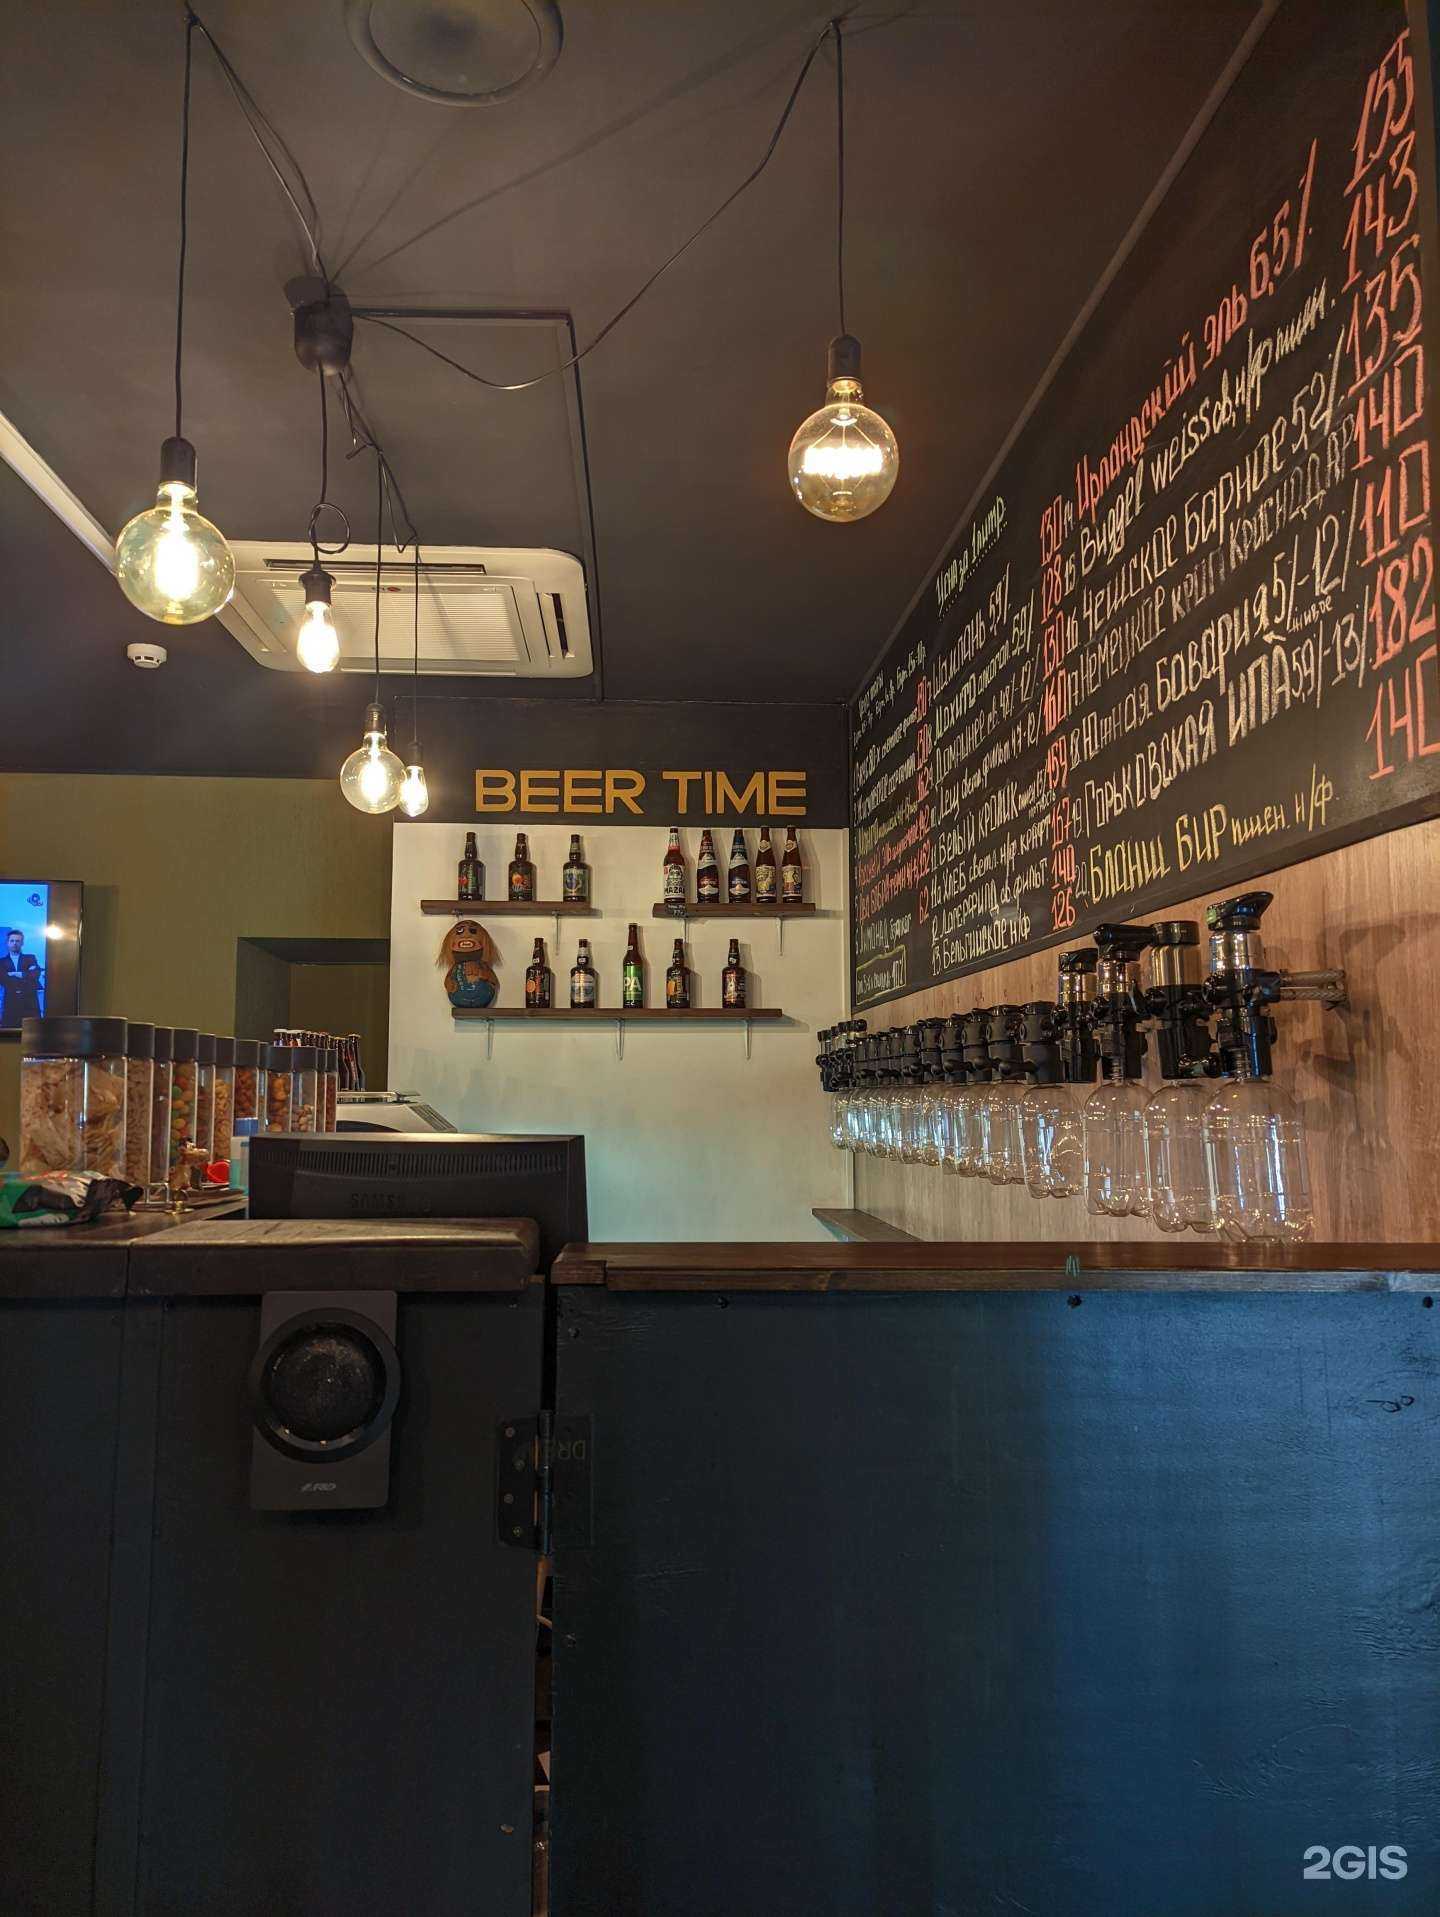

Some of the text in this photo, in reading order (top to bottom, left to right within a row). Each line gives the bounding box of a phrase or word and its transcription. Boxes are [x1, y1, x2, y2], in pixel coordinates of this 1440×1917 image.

[1344, 28, 1415, 197] 155
[1341, 130, 1418, 294] 143
[1346, 233, 1423, 399] 135
[1350, 344, 1424, 470] 140
[1040, 495, 1062, 567] 130
[1359, 440, 1431, 567] 110
[1041, 554, 1062, 625] 128
[1042, 610, 1065, 682] 130
[1228, 637, 1291, 747] ИПА
[1368, 534, 1436, 670] 182
[1043, 668, 1067, 736] 160
[475, 769, 806, 815] BEER TIME
[1051, 797, 1073, 851] 167
[1051, 844, 1077, 890] 140
[1051, 886, 1077, 931] 126
